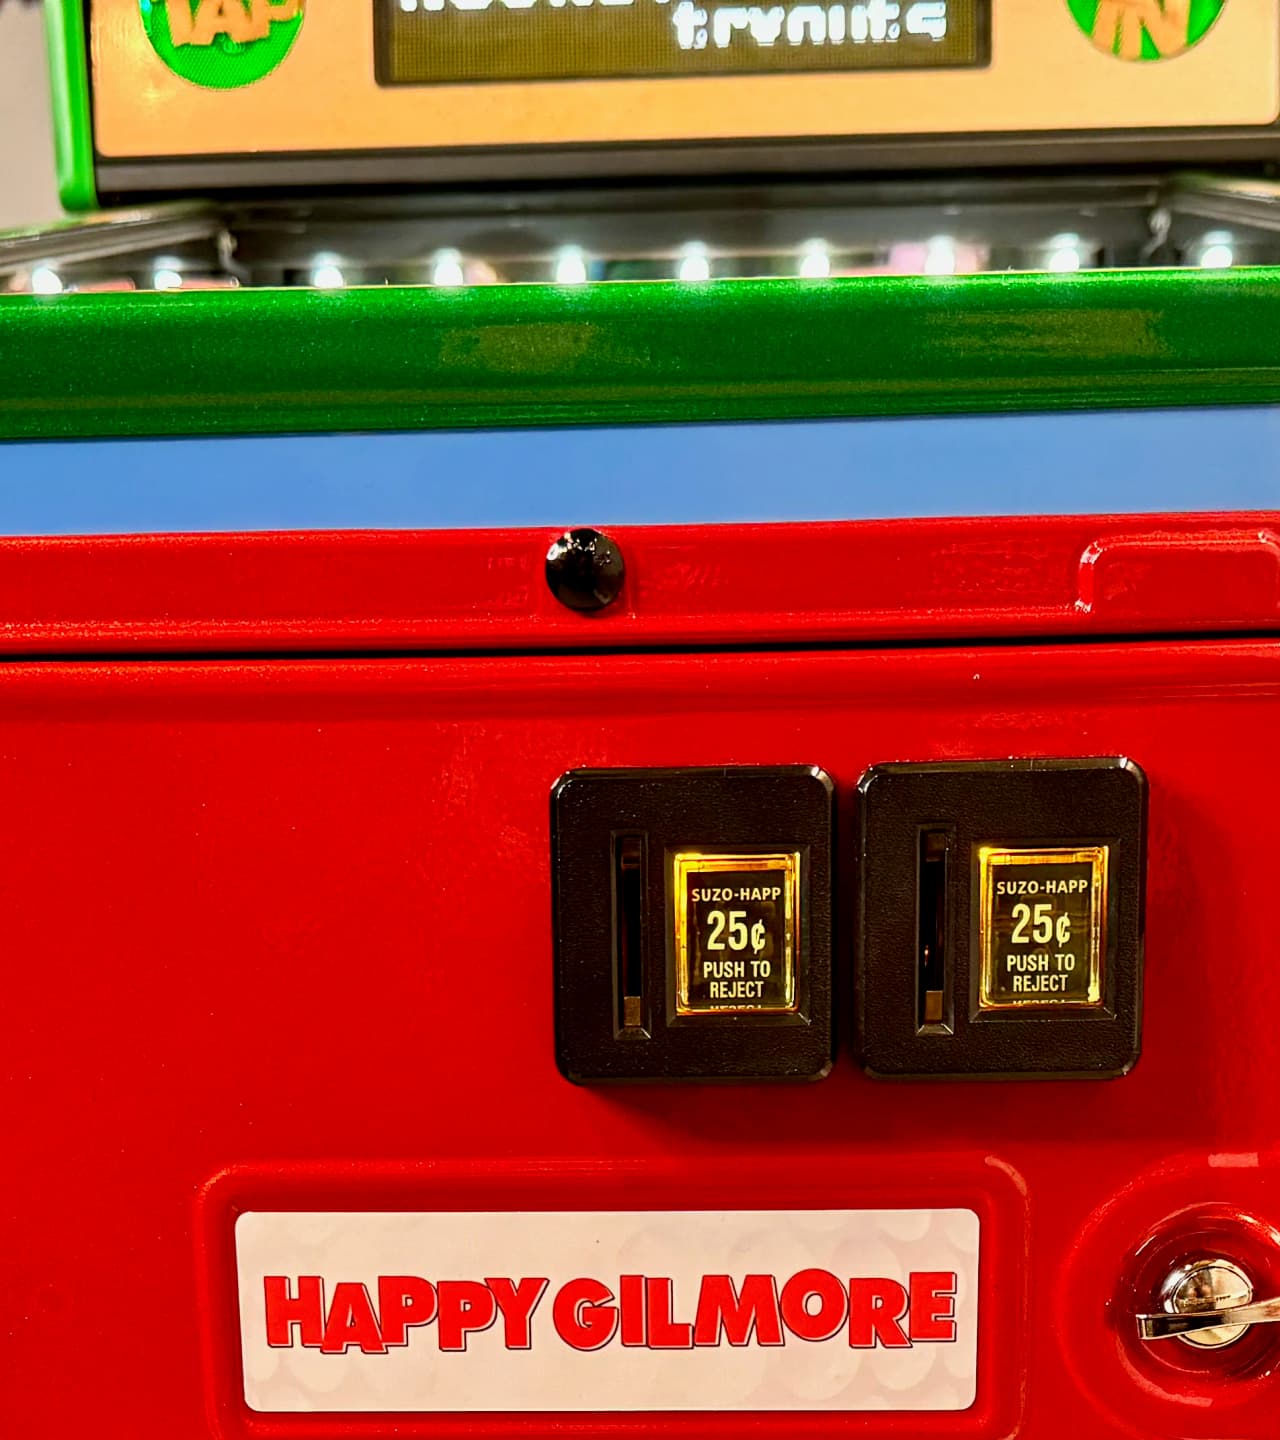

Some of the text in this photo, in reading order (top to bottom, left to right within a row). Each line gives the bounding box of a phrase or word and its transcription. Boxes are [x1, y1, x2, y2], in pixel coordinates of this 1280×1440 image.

[691, 887, 782, 902] SUZO-HAPP
[996, 879, 1089, 895] SUZO-HAPP
[706, 910, 766, 955] 25¢
[1011, 903, 1071, 948] 25¢
[703, 960, 771, 979] PUSH TO
[1006, 953, 1076, 972] PUSH TO
[709, 981, 765, 998] REJECT
[1012, 974, 1069, 992] REJECT
[263, 1267, 958, 1354] HAPPY GILMORE
